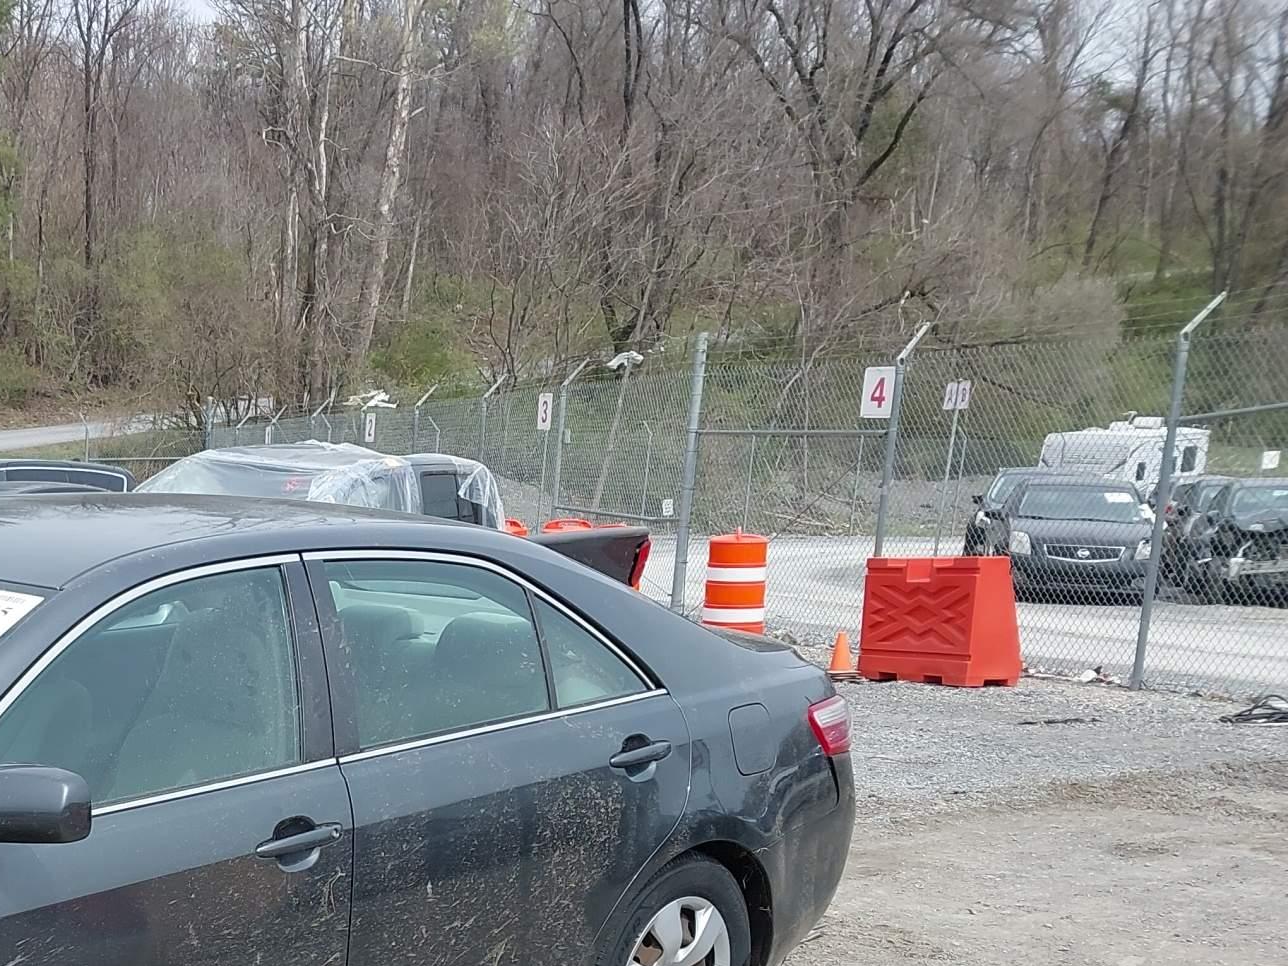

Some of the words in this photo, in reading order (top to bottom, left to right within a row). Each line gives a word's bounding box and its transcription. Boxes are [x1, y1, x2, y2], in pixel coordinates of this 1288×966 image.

[870, 376, 886, 409] 4
[541, 400, 549, 424] 3
[367, 419, 374, 437] 2
